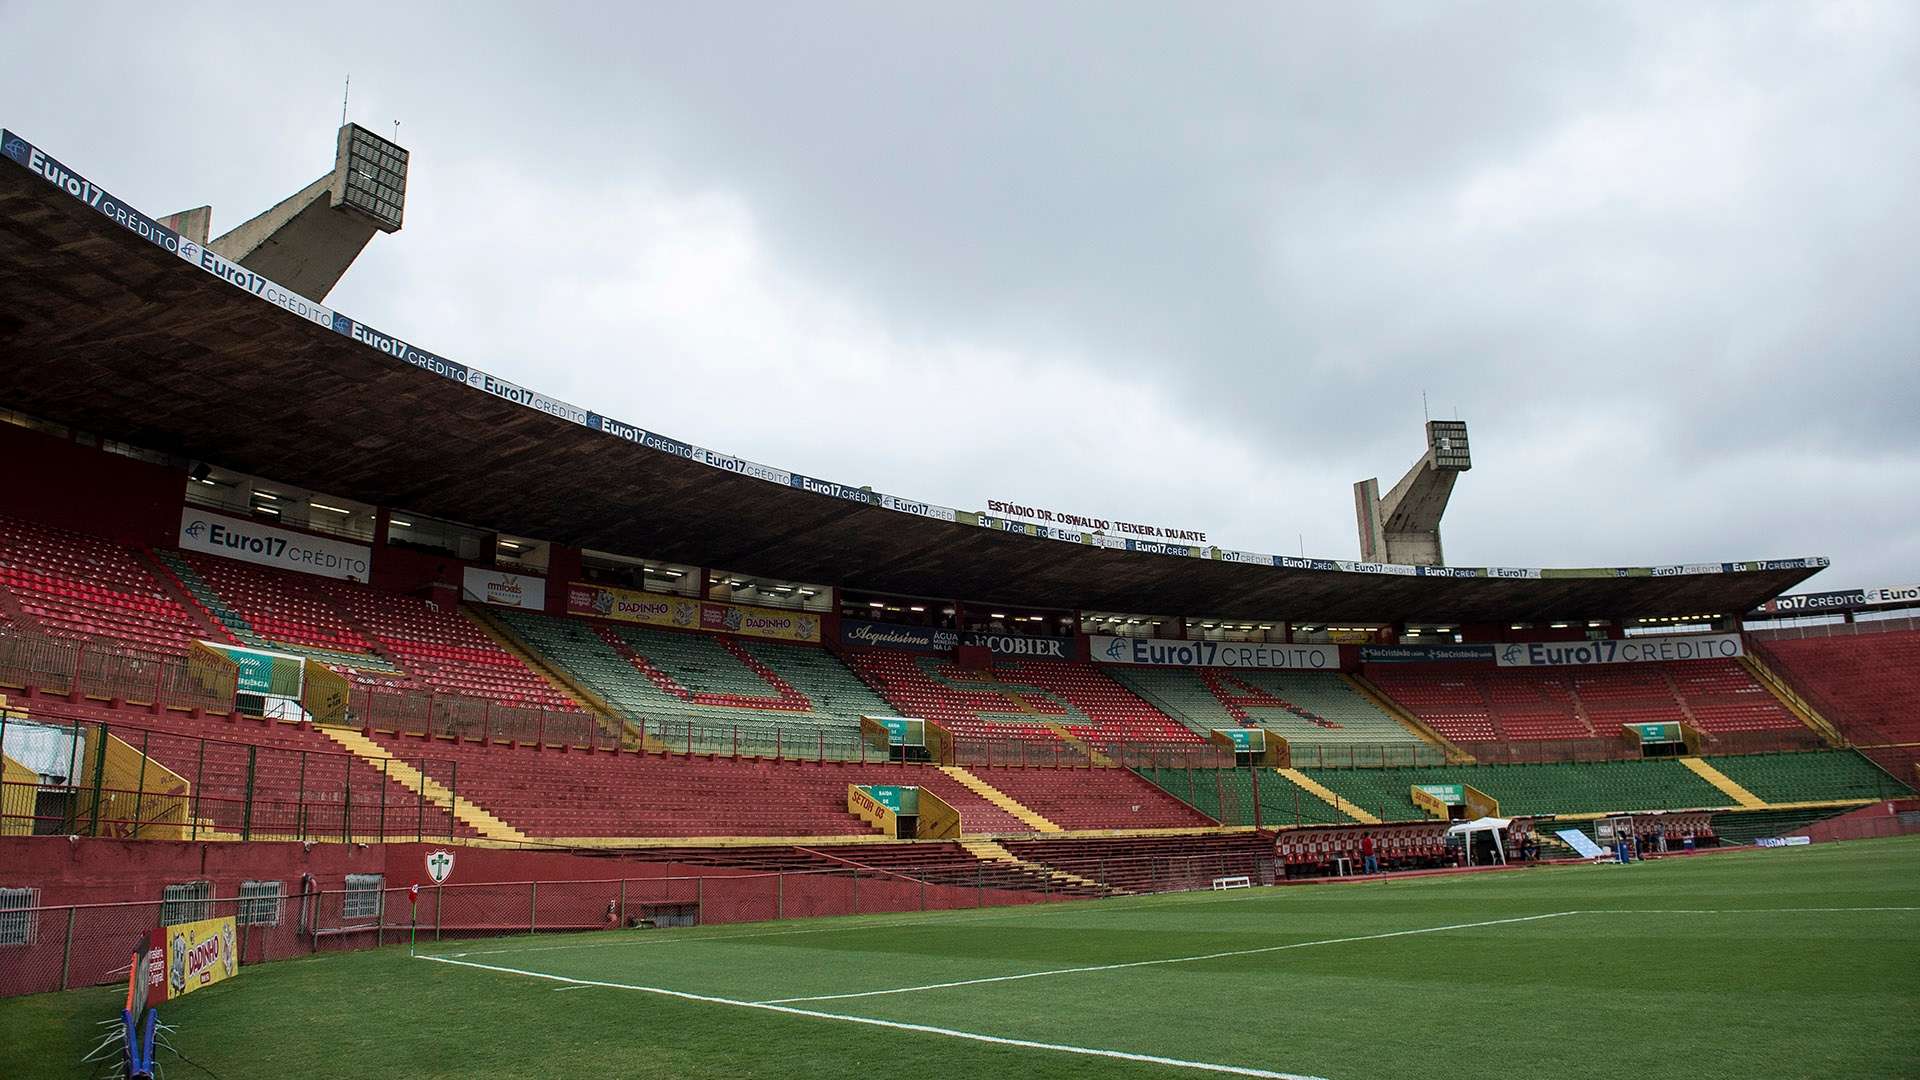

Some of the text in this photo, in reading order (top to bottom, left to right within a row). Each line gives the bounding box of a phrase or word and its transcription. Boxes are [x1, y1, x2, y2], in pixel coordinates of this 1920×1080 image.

[29, 149, 177, 252] Euro17 CRÉDITO
[201, 250, 332, 328] Euro17 CRÉDITO
[351, 322, 466, 383] Euro17 CRÉDITO
[484, 377, 586, 425] Euro17 CRÉDITO
[601, 417, 692, 459] Euro17 CRÉDITO
[705, 451, 790, 485] Euro17 CRÉDITO
[803, 477, 881, 506] Euro17 CRÉDI
[893, 498, 955, 521] Euro17 CRÉDI
[988, 500, 1207, 542] ESTÁDIO DR. OSWALDO TEIXEIRA DUARTE
[978, 516, 1012, 532] Eu17
[209, 524, 366, 574] Euro17 CRÉDITO
[1135, 541, 1166, 554] Euro17
[1282, 557, 1312, 569] Euro17
[1354, 562, 1383, 573] Euro17
[1424, 567, 1454, 577] Euro17
[1808, 593, 1866, 608] CRÉDITO
[1880, 586, 1920, 600] Euro
[618, 601, 669, 615] DADINHO
[746, 618, 791, 629] DADINHO
[848, 625, 929, 645] Acquissima
[1133, 640, 1326, 668] Euro17 CRÉDITO
[1528, 638, 1738, 665] Euro17 CRÉDITO
[851, 791, 874, 813] SETOR
[188, 935, 219, 976] DADINHO
